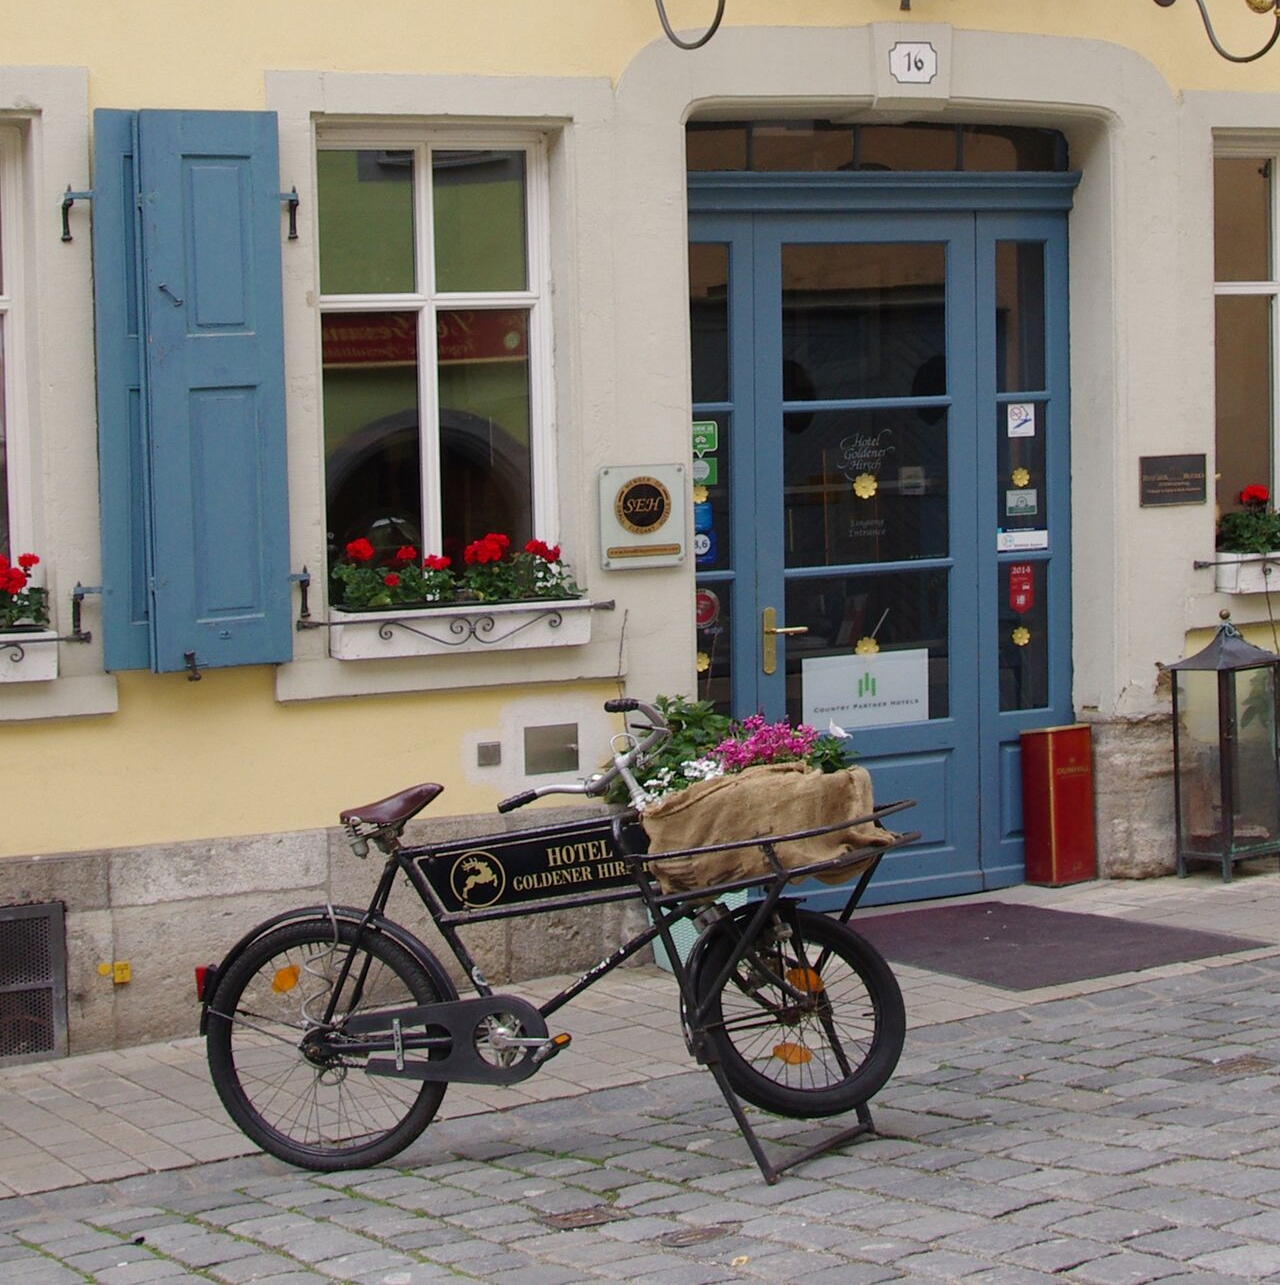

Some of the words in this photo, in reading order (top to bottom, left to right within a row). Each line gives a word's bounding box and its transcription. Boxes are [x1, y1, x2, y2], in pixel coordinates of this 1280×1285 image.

[902, 50, 924, 72] 16
[624, 498, 662, 513] SEH
[1012, 566, 1031, 574] 2014
[545, 839, 613, 867] HOTEL
[513, 865, 593, 891] GOLDENER
[598, 859, 650, 879] HIR
